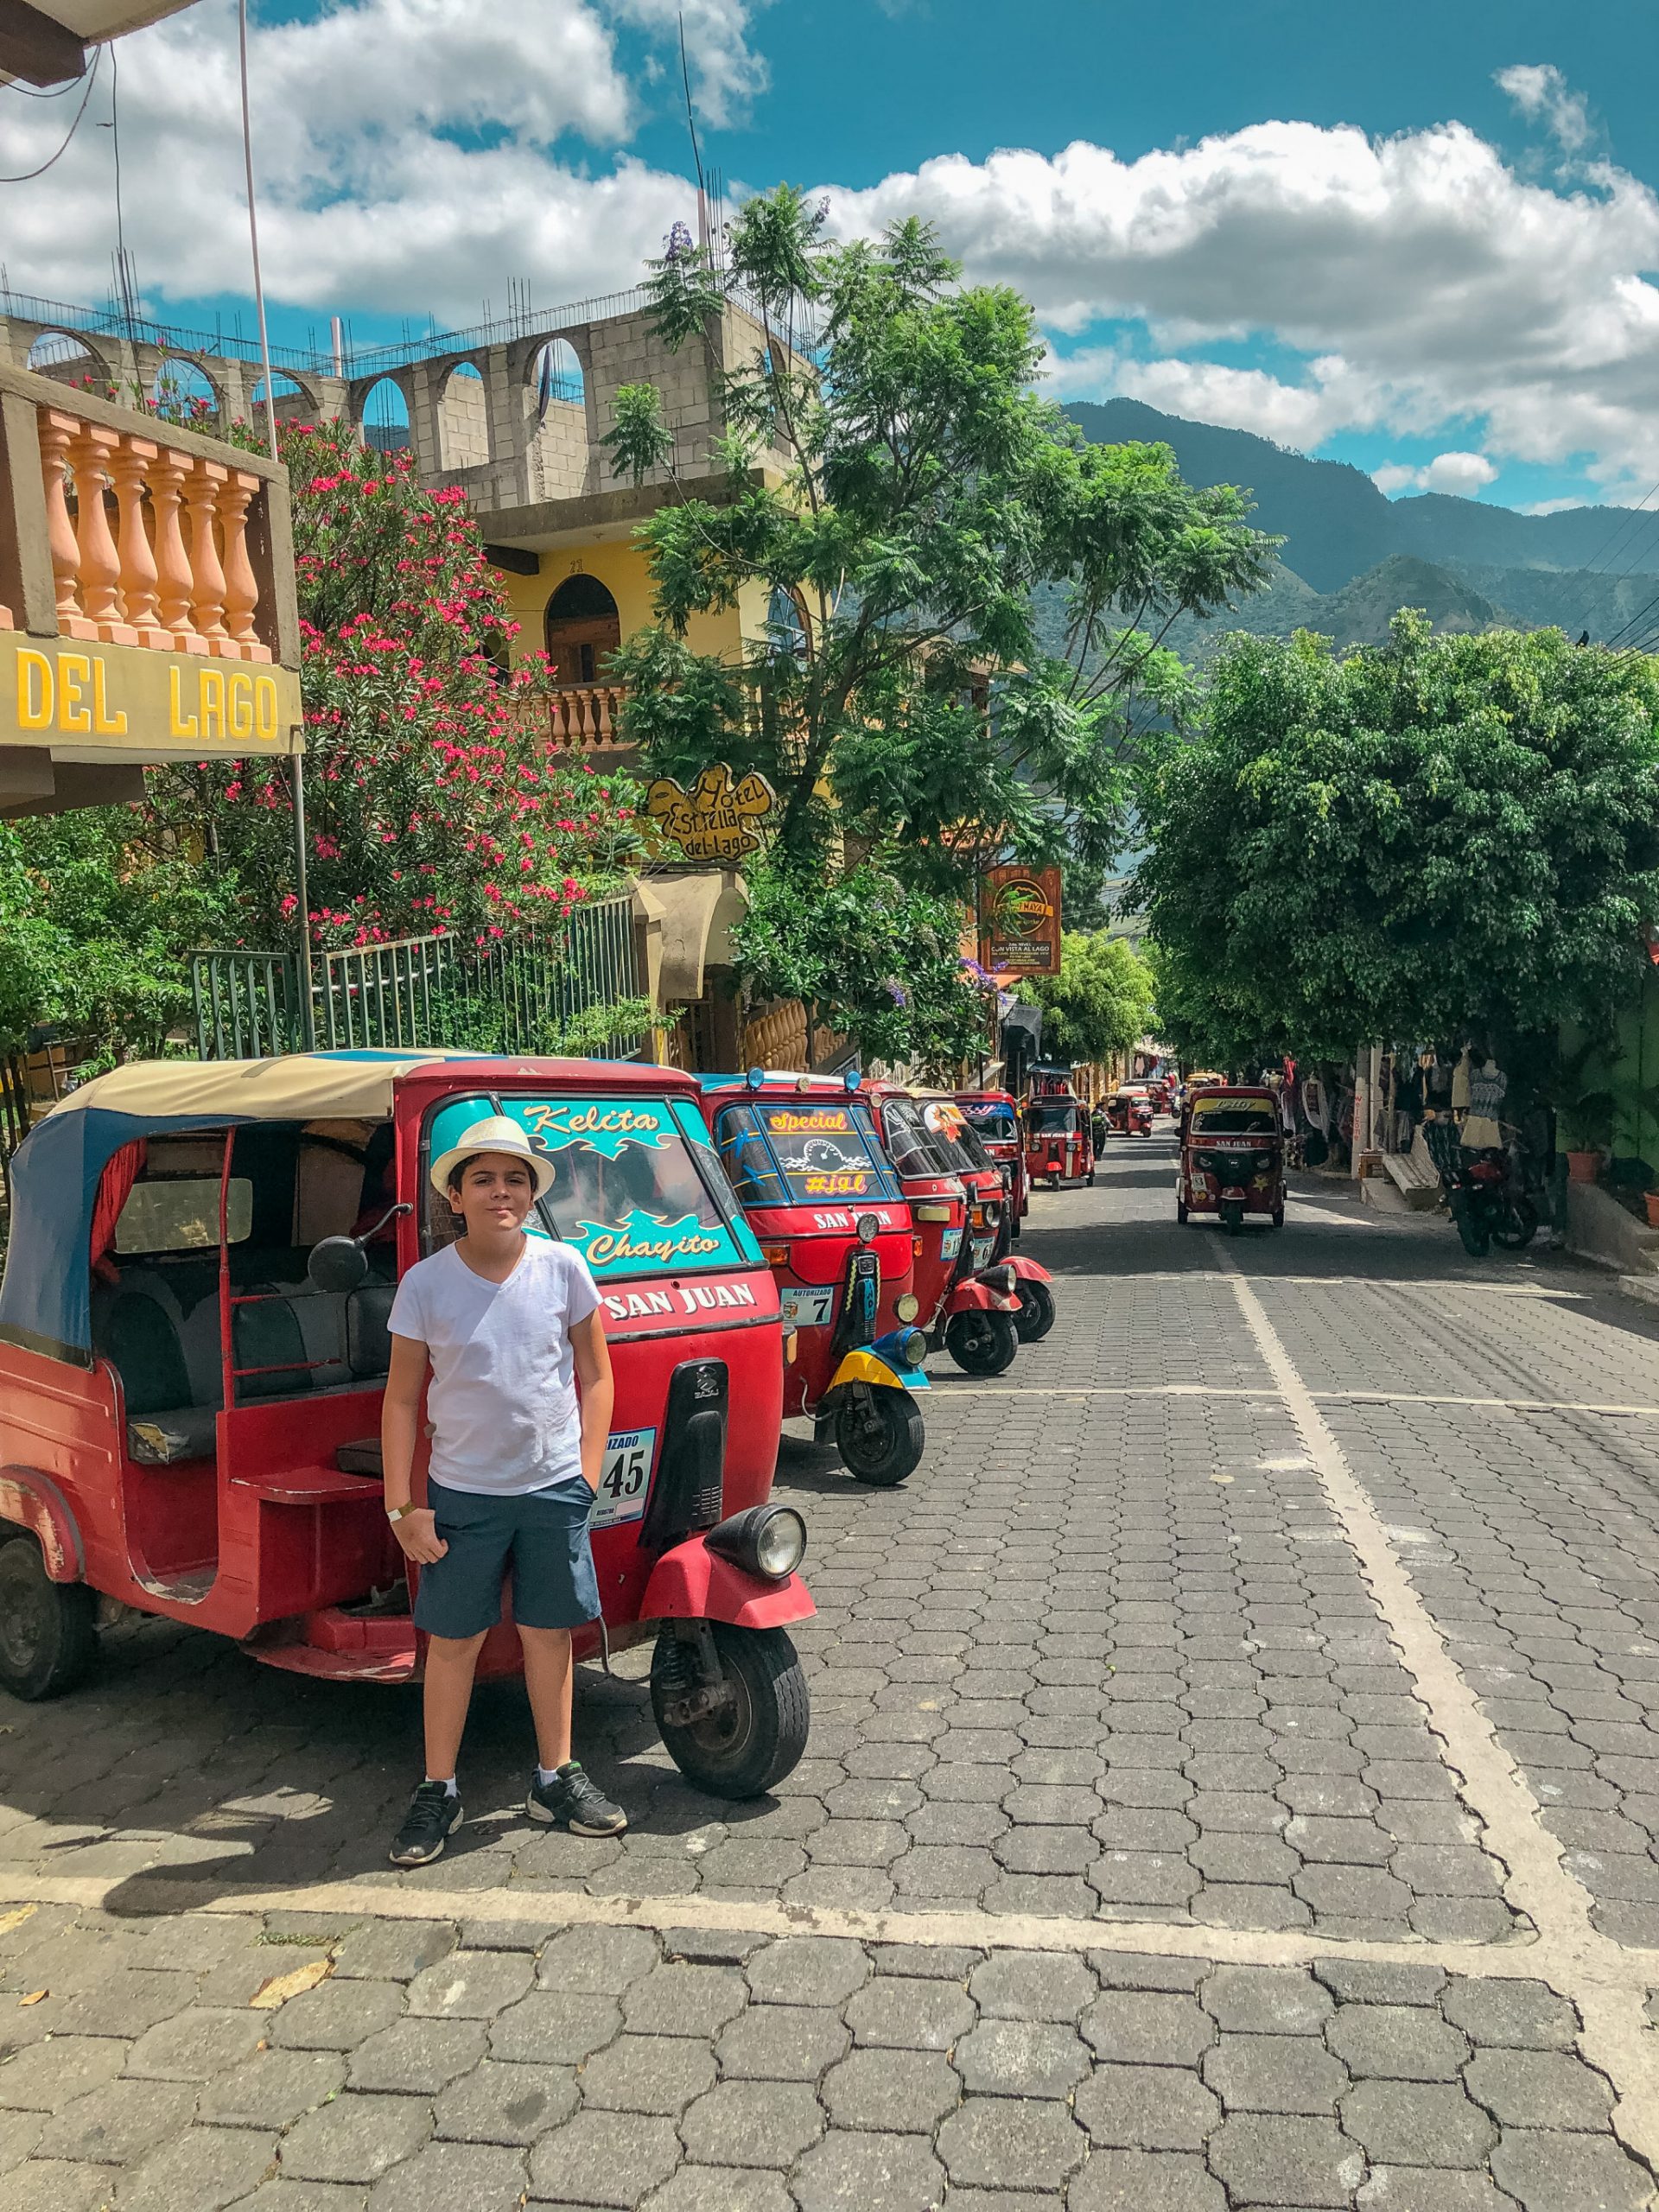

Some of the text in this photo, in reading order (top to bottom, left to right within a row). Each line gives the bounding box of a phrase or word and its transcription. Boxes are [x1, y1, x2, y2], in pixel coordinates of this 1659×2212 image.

[16, 647, 278, 741] DEL LAGO
[670, 802, 738, 835] Estrella
[1024, 903, 1042, 912] MAYA
[524, 1104, 659, 1134] Kelita
[770, 1111, 849, 1132] Special
[813, 1212, 849, 1230] SAN
[587, 1234, 720, 1266] Chayito
[604, 1283, 757, 1321] SAN JUAN
[793, 1288, 831, 1297] AUTORIZADO
[813, 1298, 830, 1323] 7
